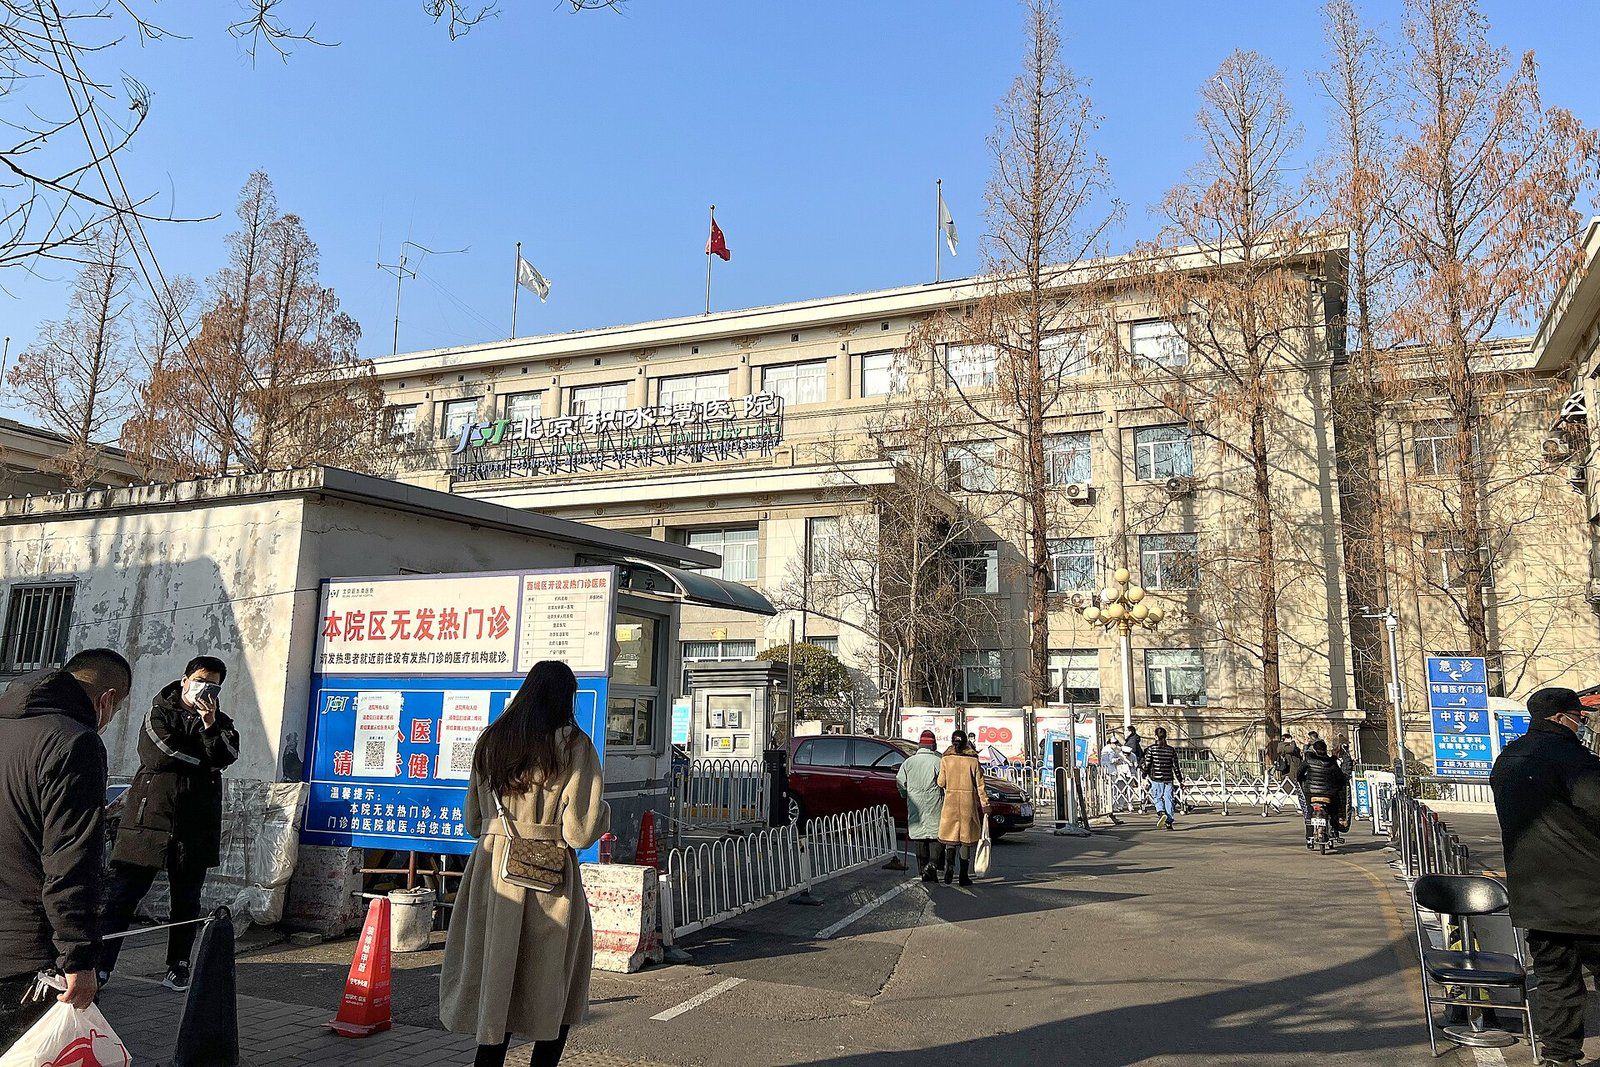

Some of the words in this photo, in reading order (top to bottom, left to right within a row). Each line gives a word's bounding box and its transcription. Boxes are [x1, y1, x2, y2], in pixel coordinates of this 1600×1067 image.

[511, 389, 779, 441] 北京积水潭医院
[704, 422, 782, 440] HOSPITAL
[526, 578, 606, 591] 西城区开设发热门诊医院
[321, 605, 511, 642] 本院区无发热门诊
[1439, 660, 1473, 672] 急诊
[1440, 711, 1479, 722] 中药房
[330, 786, 381, 801] 温馨提示：
[327, 815, 469, 837] 门诊的医院就医。给您造成
